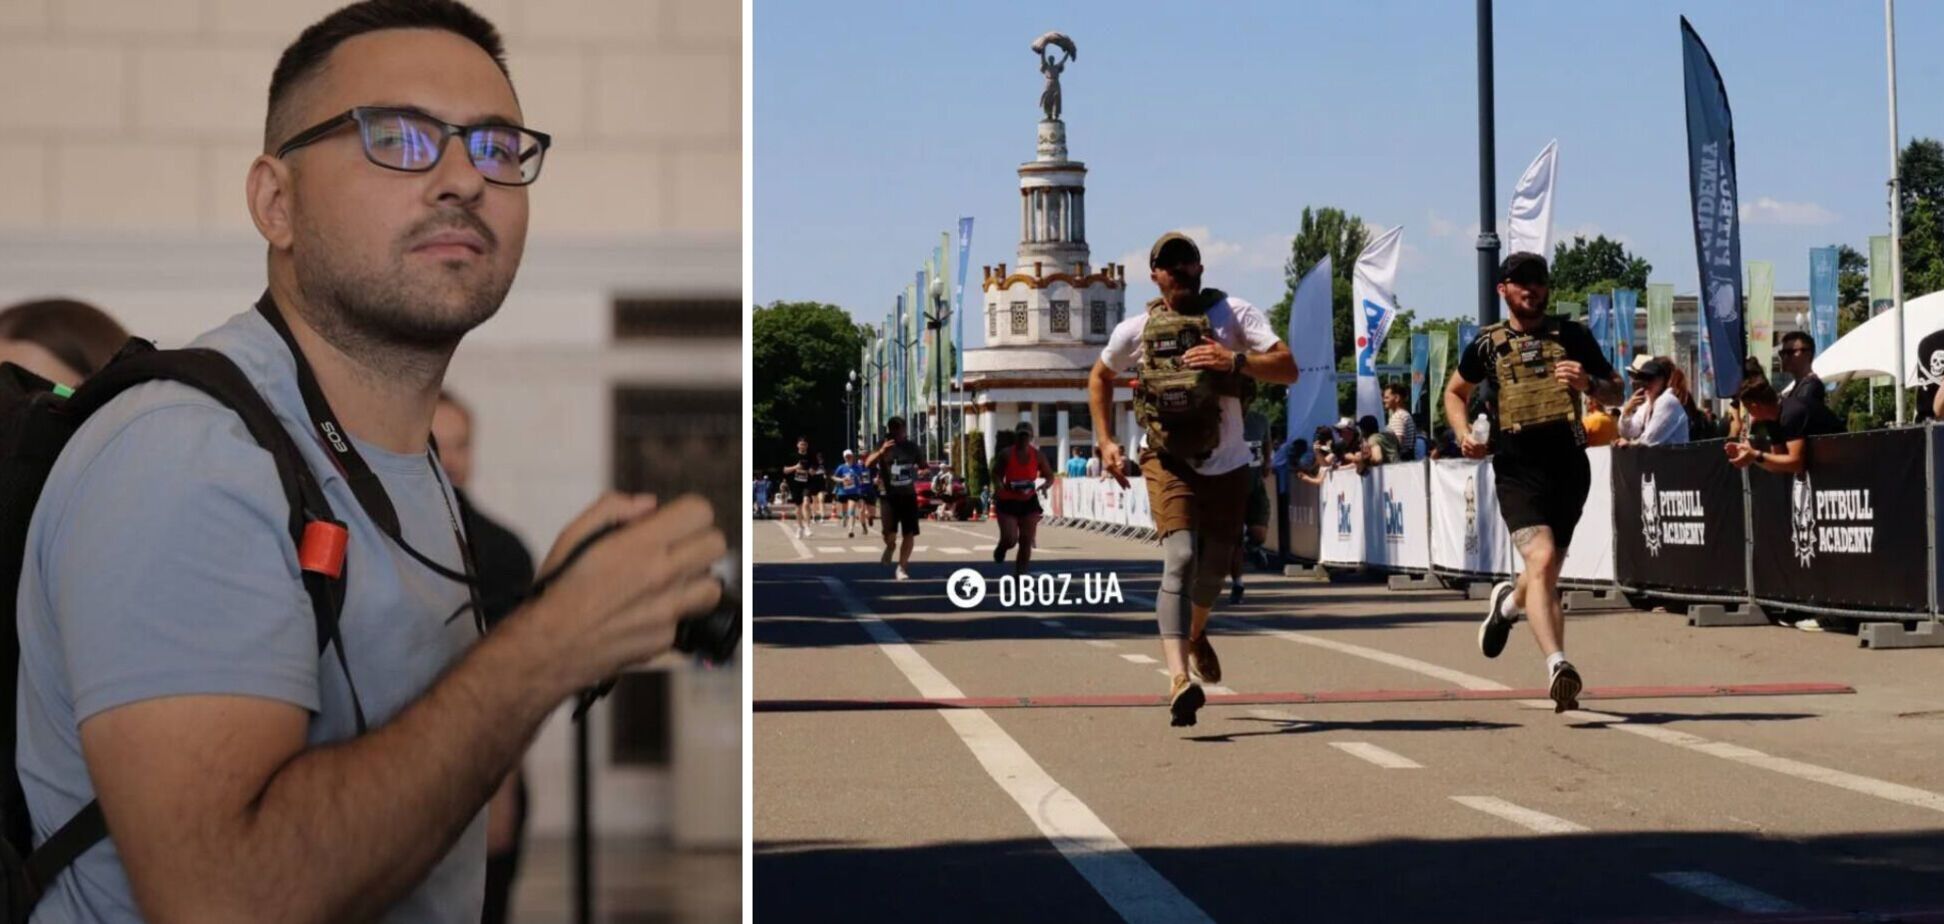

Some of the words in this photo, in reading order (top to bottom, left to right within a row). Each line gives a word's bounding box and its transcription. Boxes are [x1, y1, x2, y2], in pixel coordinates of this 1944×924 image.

[320, 420, 348, 452] EOS
[1659, 490, 1704, 517] PITBULL
[1815, 489, 1873, 520] PITBULL
[1662, 521, 1705, 545] ACADEMY
[1818, 526, 1874, 553] ACADEMY
